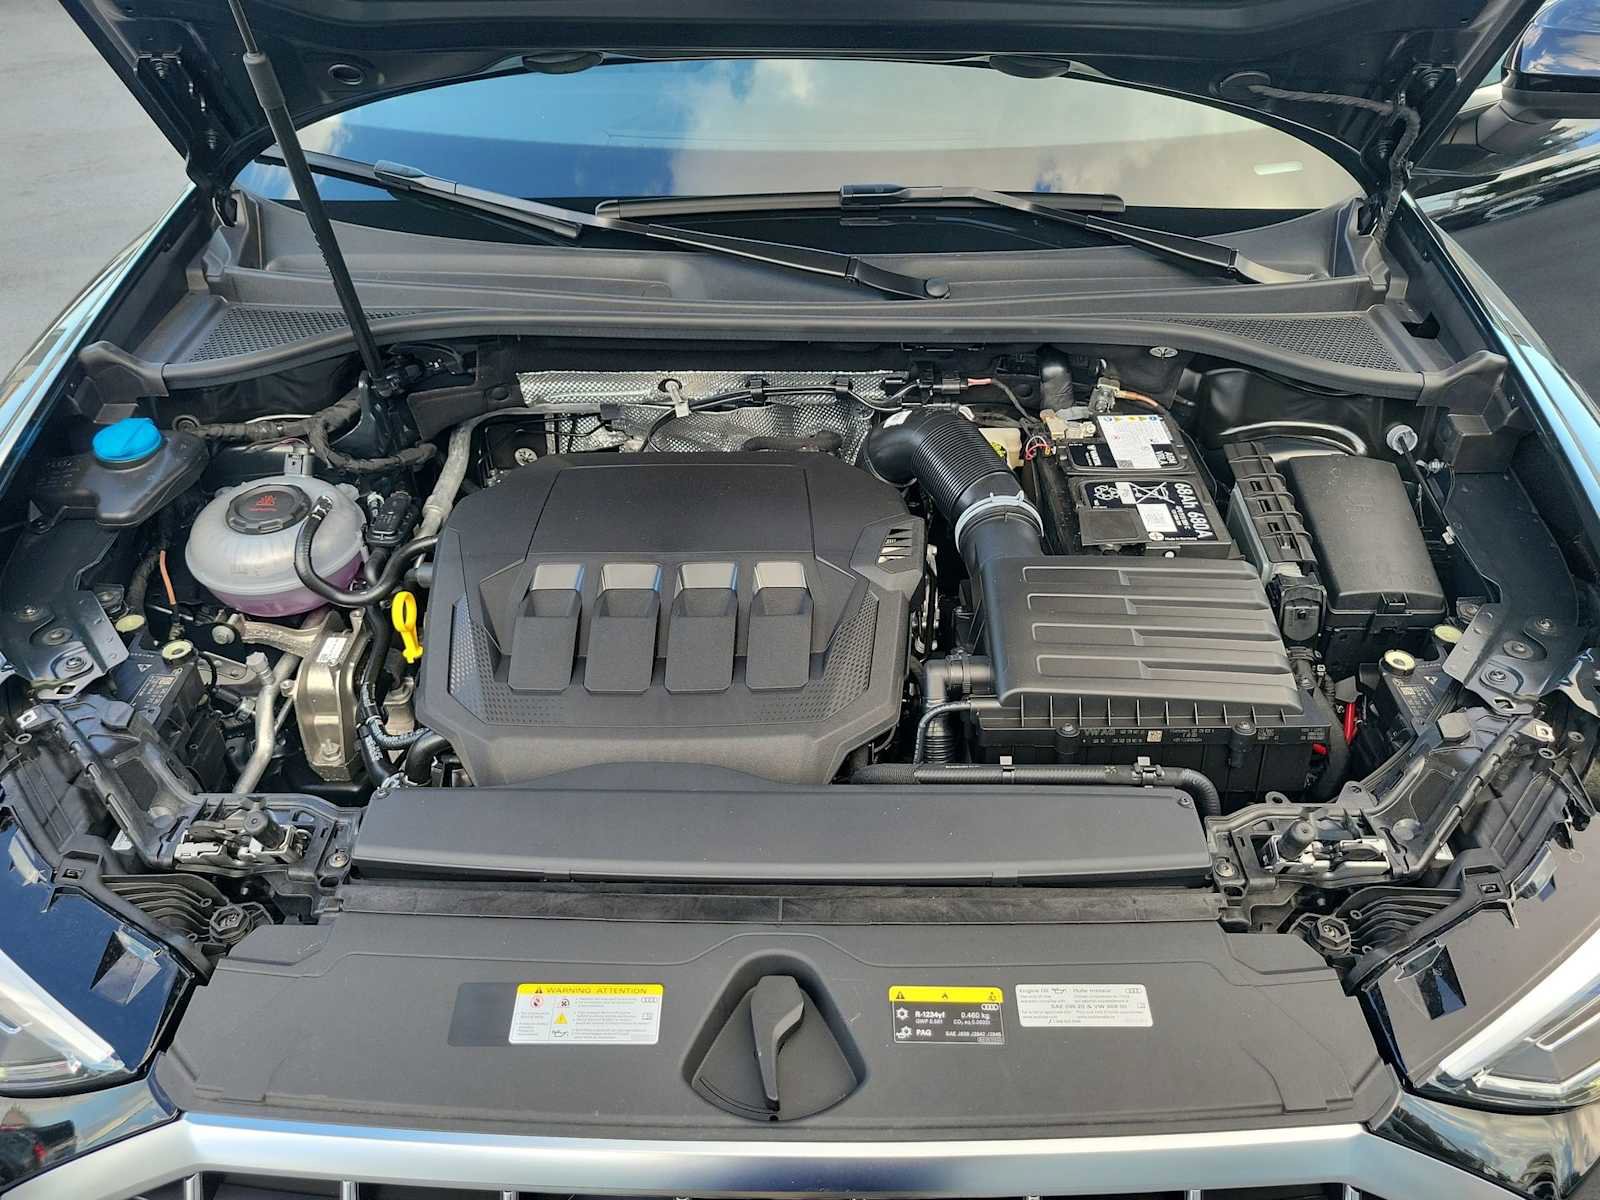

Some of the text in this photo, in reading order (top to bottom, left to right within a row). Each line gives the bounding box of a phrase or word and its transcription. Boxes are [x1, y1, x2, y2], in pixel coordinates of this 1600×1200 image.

[1174, 482, 1199, 509] 68Ah
[1187, 511, 1214, 539] 680A
[546, 986, 592, 994] WARNING
[981, 1012, 991, 1020] kg
